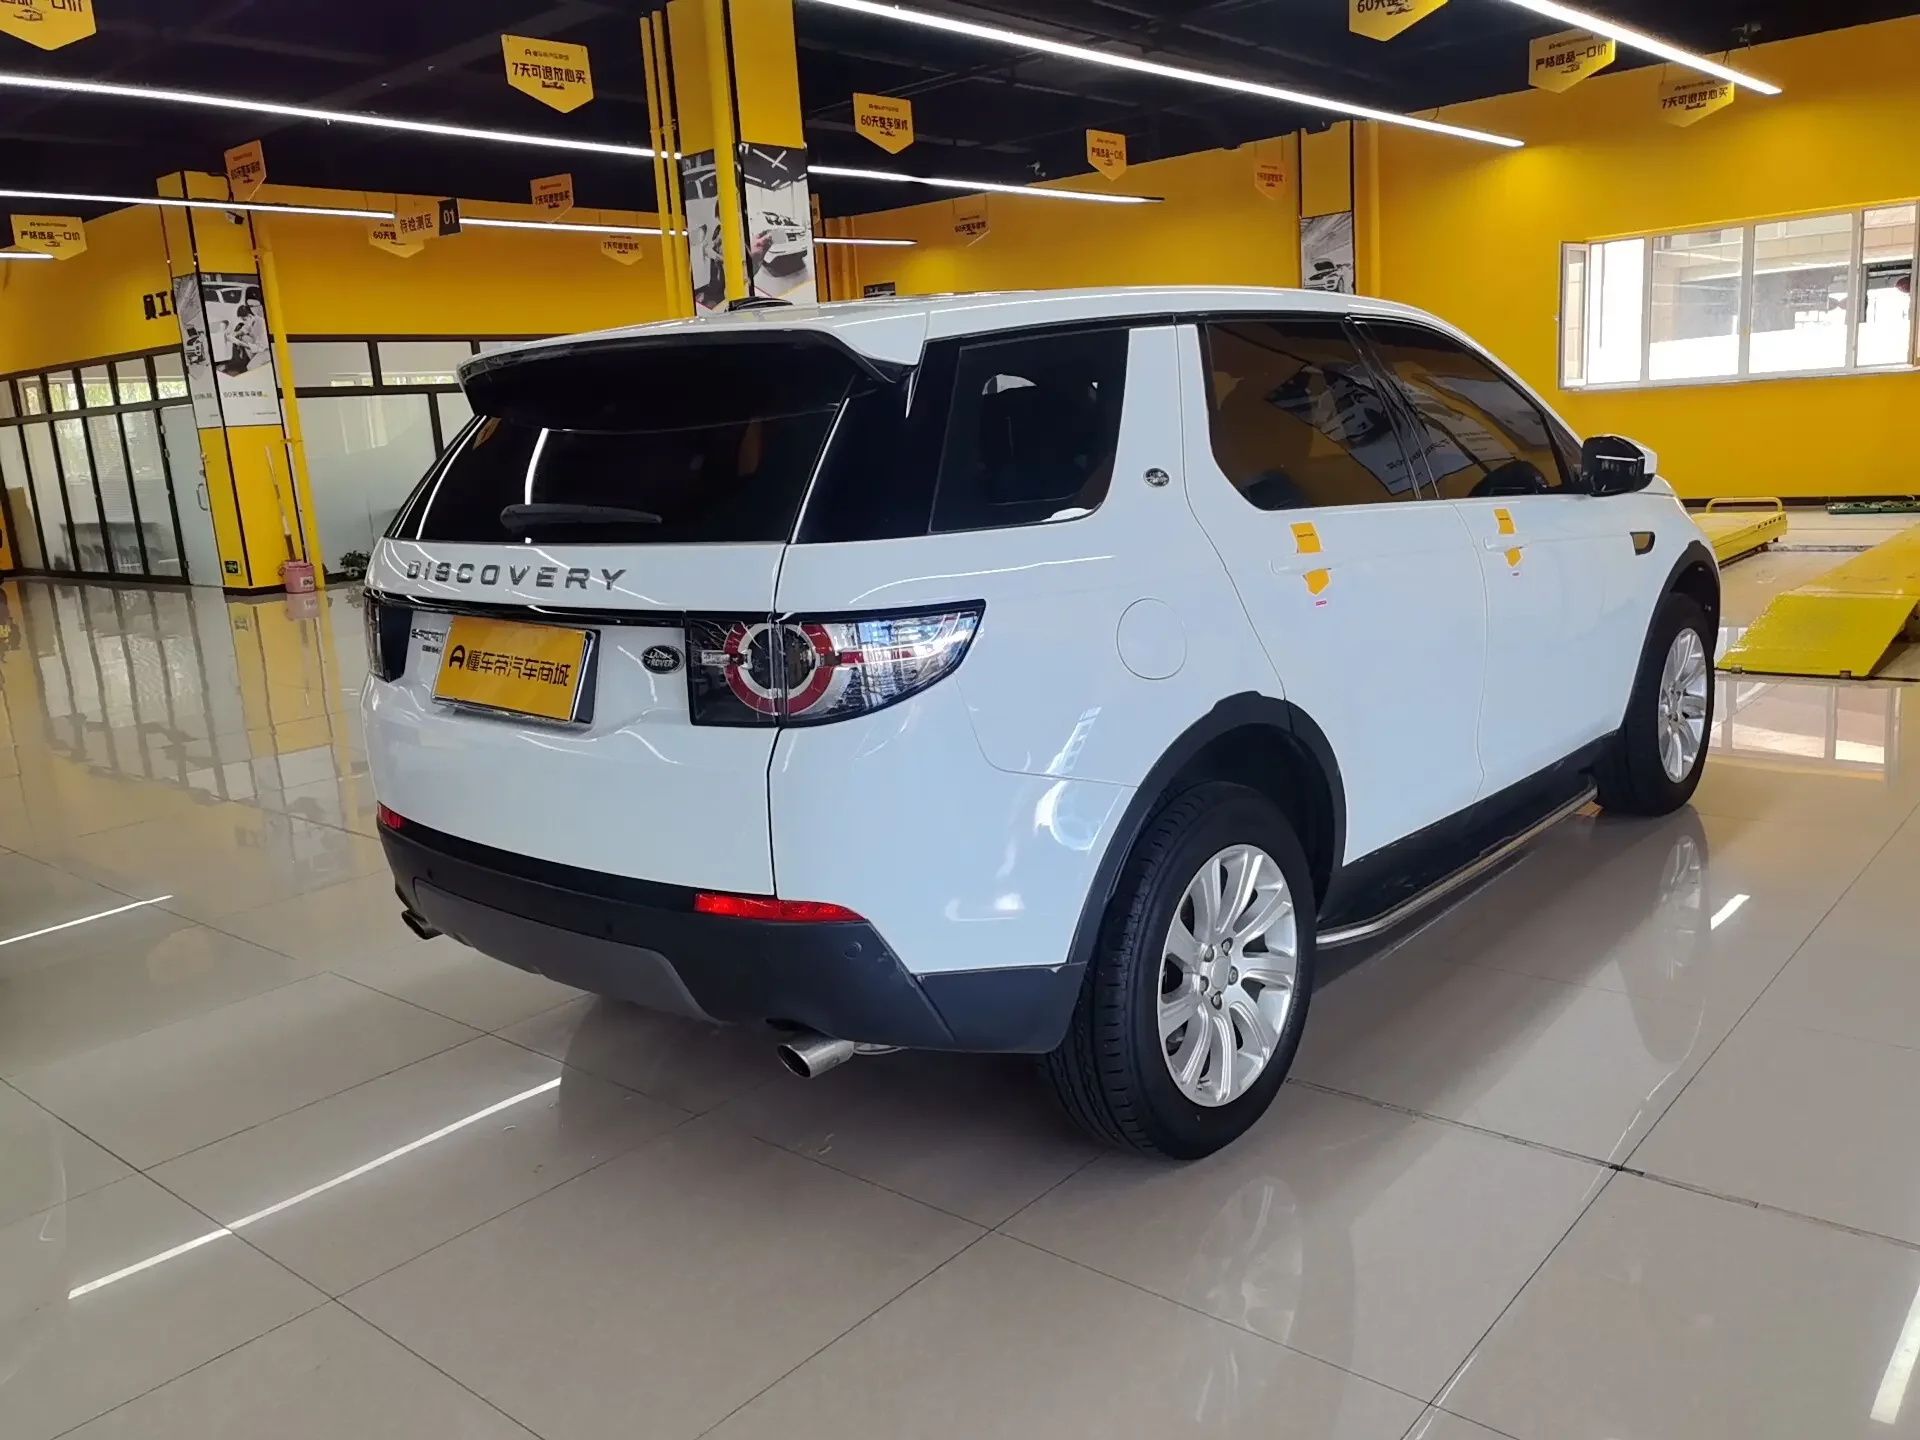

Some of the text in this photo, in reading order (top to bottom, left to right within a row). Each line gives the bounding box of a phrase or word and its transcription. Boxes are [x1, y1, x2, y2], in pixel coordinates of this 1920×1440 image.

[511, 62, 586, 85] 7天可退放心买
[1661, 87, 1729, 110] 7天可退放心买
[399, 208, 456, 236] 待检测区 01
[143, 290, 178, 321] 员工
[406, 560, 627, 591] DISCOVERY
[465, 649, 572, 687] 懂车帝汽车商城
